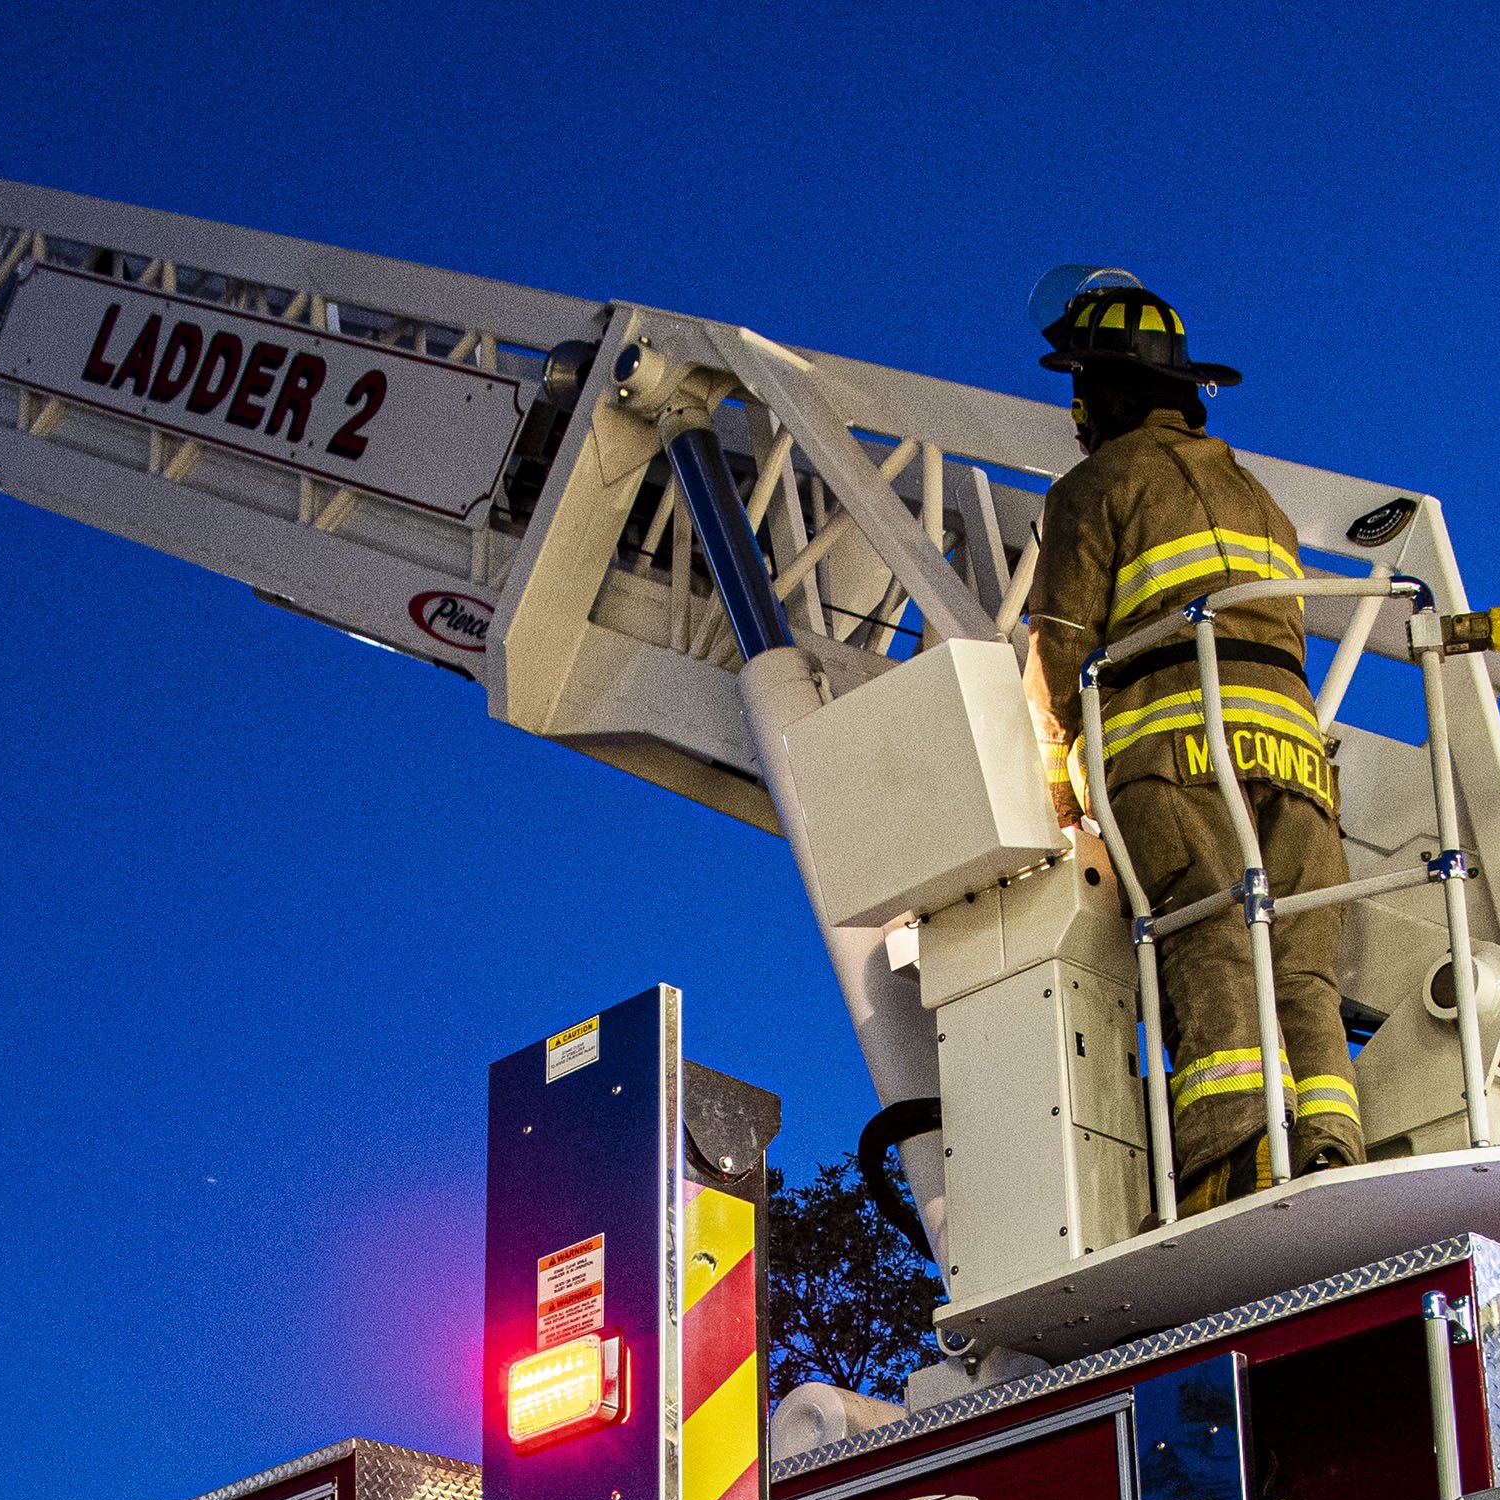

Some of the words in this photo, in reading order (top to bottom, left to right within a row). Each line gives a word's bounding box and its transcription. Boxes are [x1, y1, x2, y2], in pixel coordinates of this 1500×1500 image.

[81, 303, 327, 443] LADDER
[325, 368, 389, 462] 2
[428, 596, 490, 640] Pierce
[1185, 729, 1334, 810] MCONNELL
[562, 1022, 594, 1042] CAUTION
[556, 1241, 594, 1262] WARNING
[556, 1287, 594, 1308] WARNING
